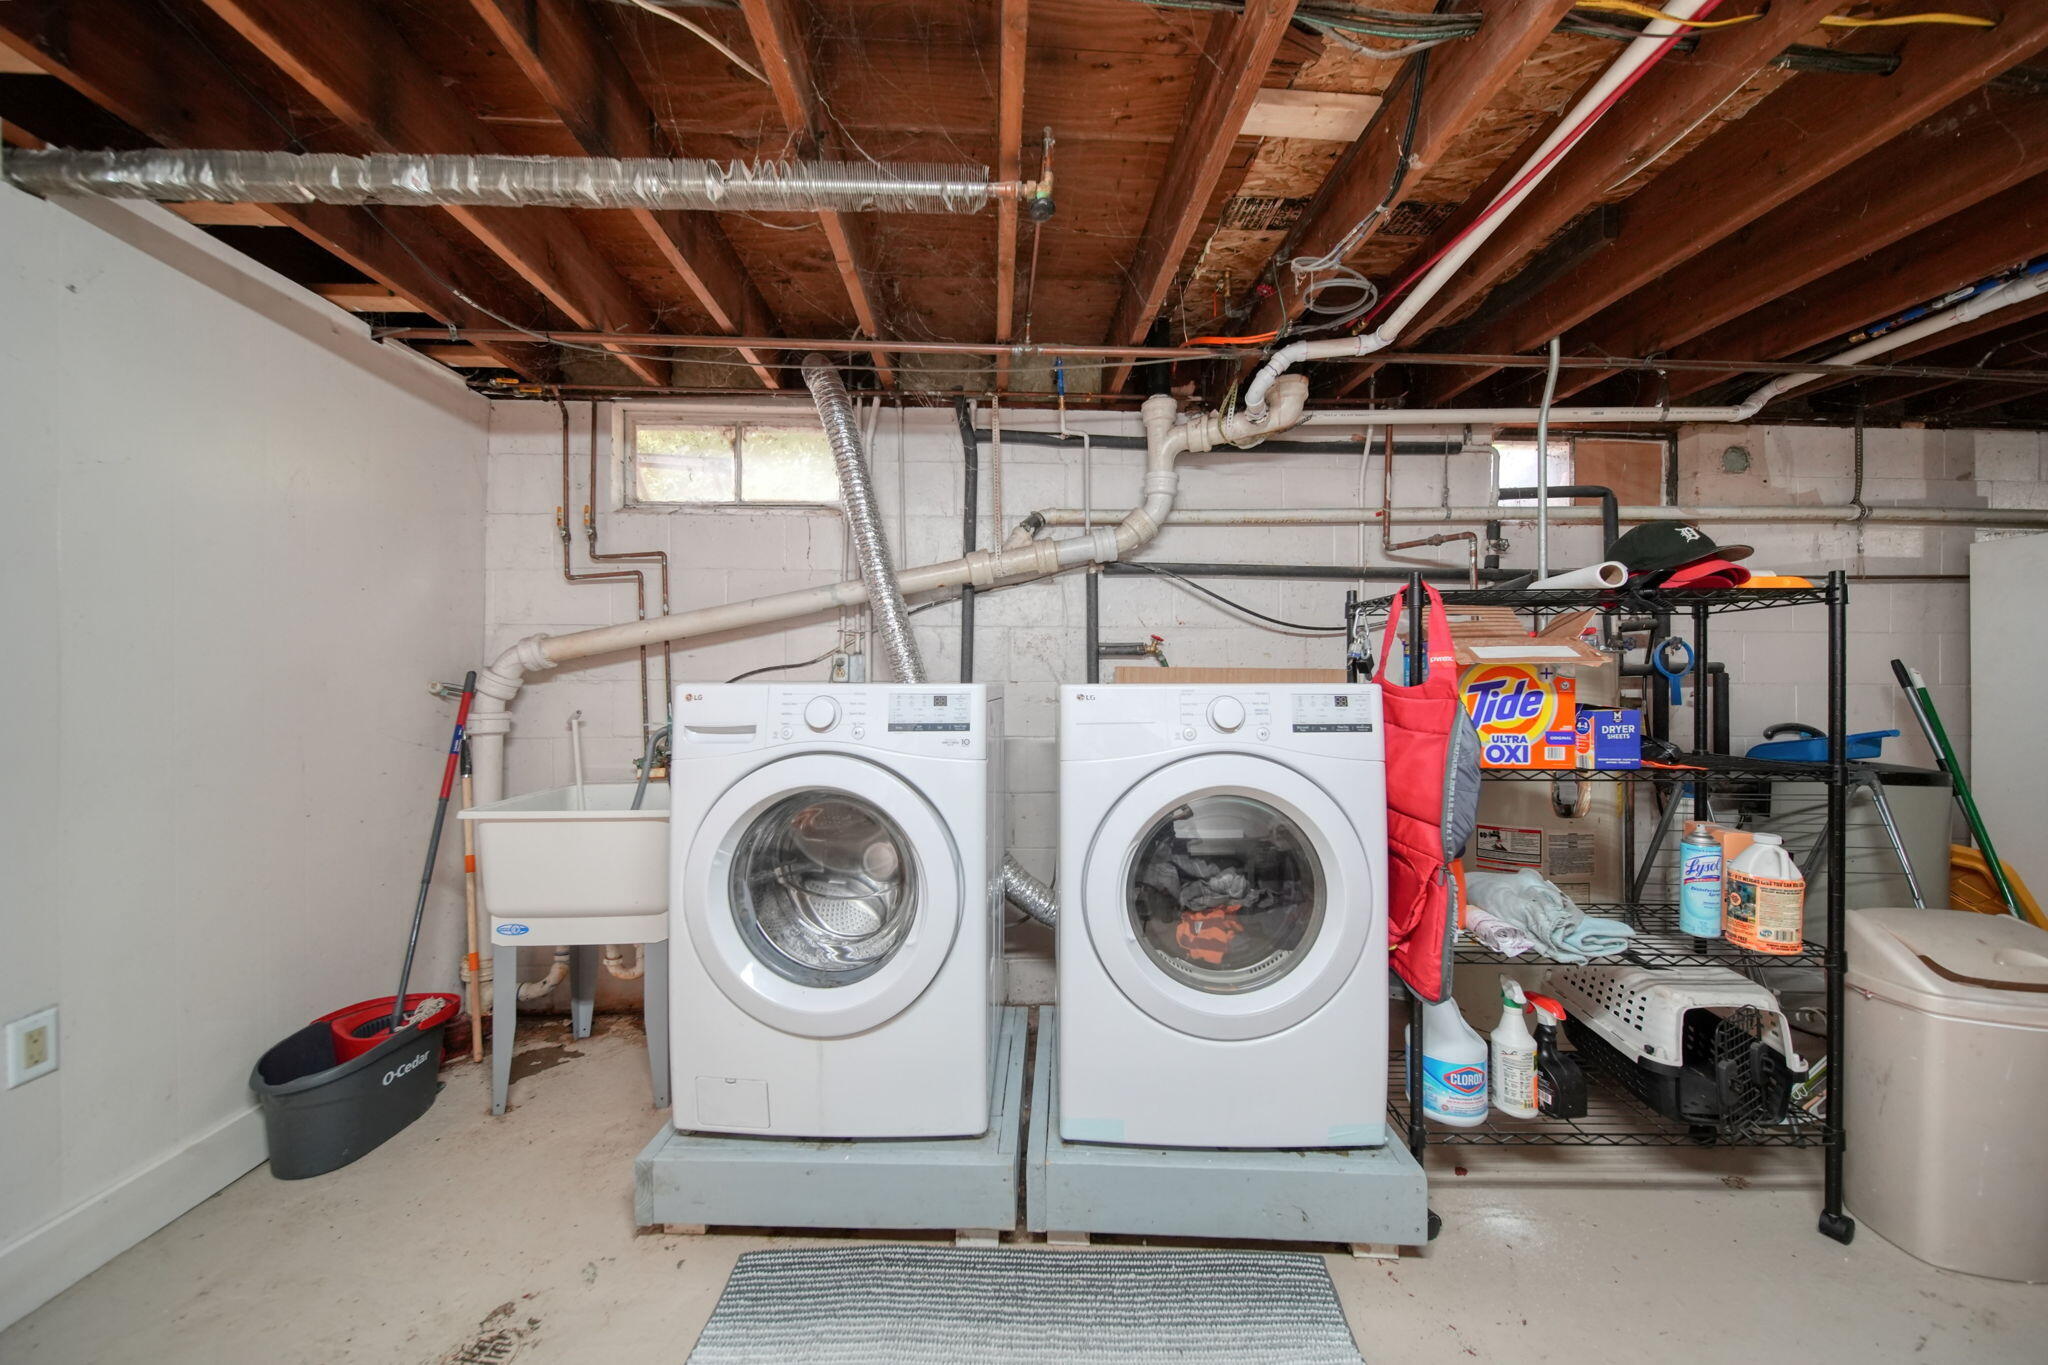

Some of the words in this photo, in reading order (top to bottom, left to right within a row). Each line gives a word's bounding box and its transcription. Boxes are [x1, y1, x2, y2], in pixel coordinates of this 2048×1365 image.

[1466, 678, 1545, 731] Tide
[1601, 724, 1636, 734] DRYER
[1491, 735, 1528, 744] ULTRA
[1485, 744, 1530, 764] OXI
[1685, 858, 1721, 877] Lysol
[382, 1050, 431, 1087] O-Cedar
[1450, 1073, 1483, 1086] CLOROX
